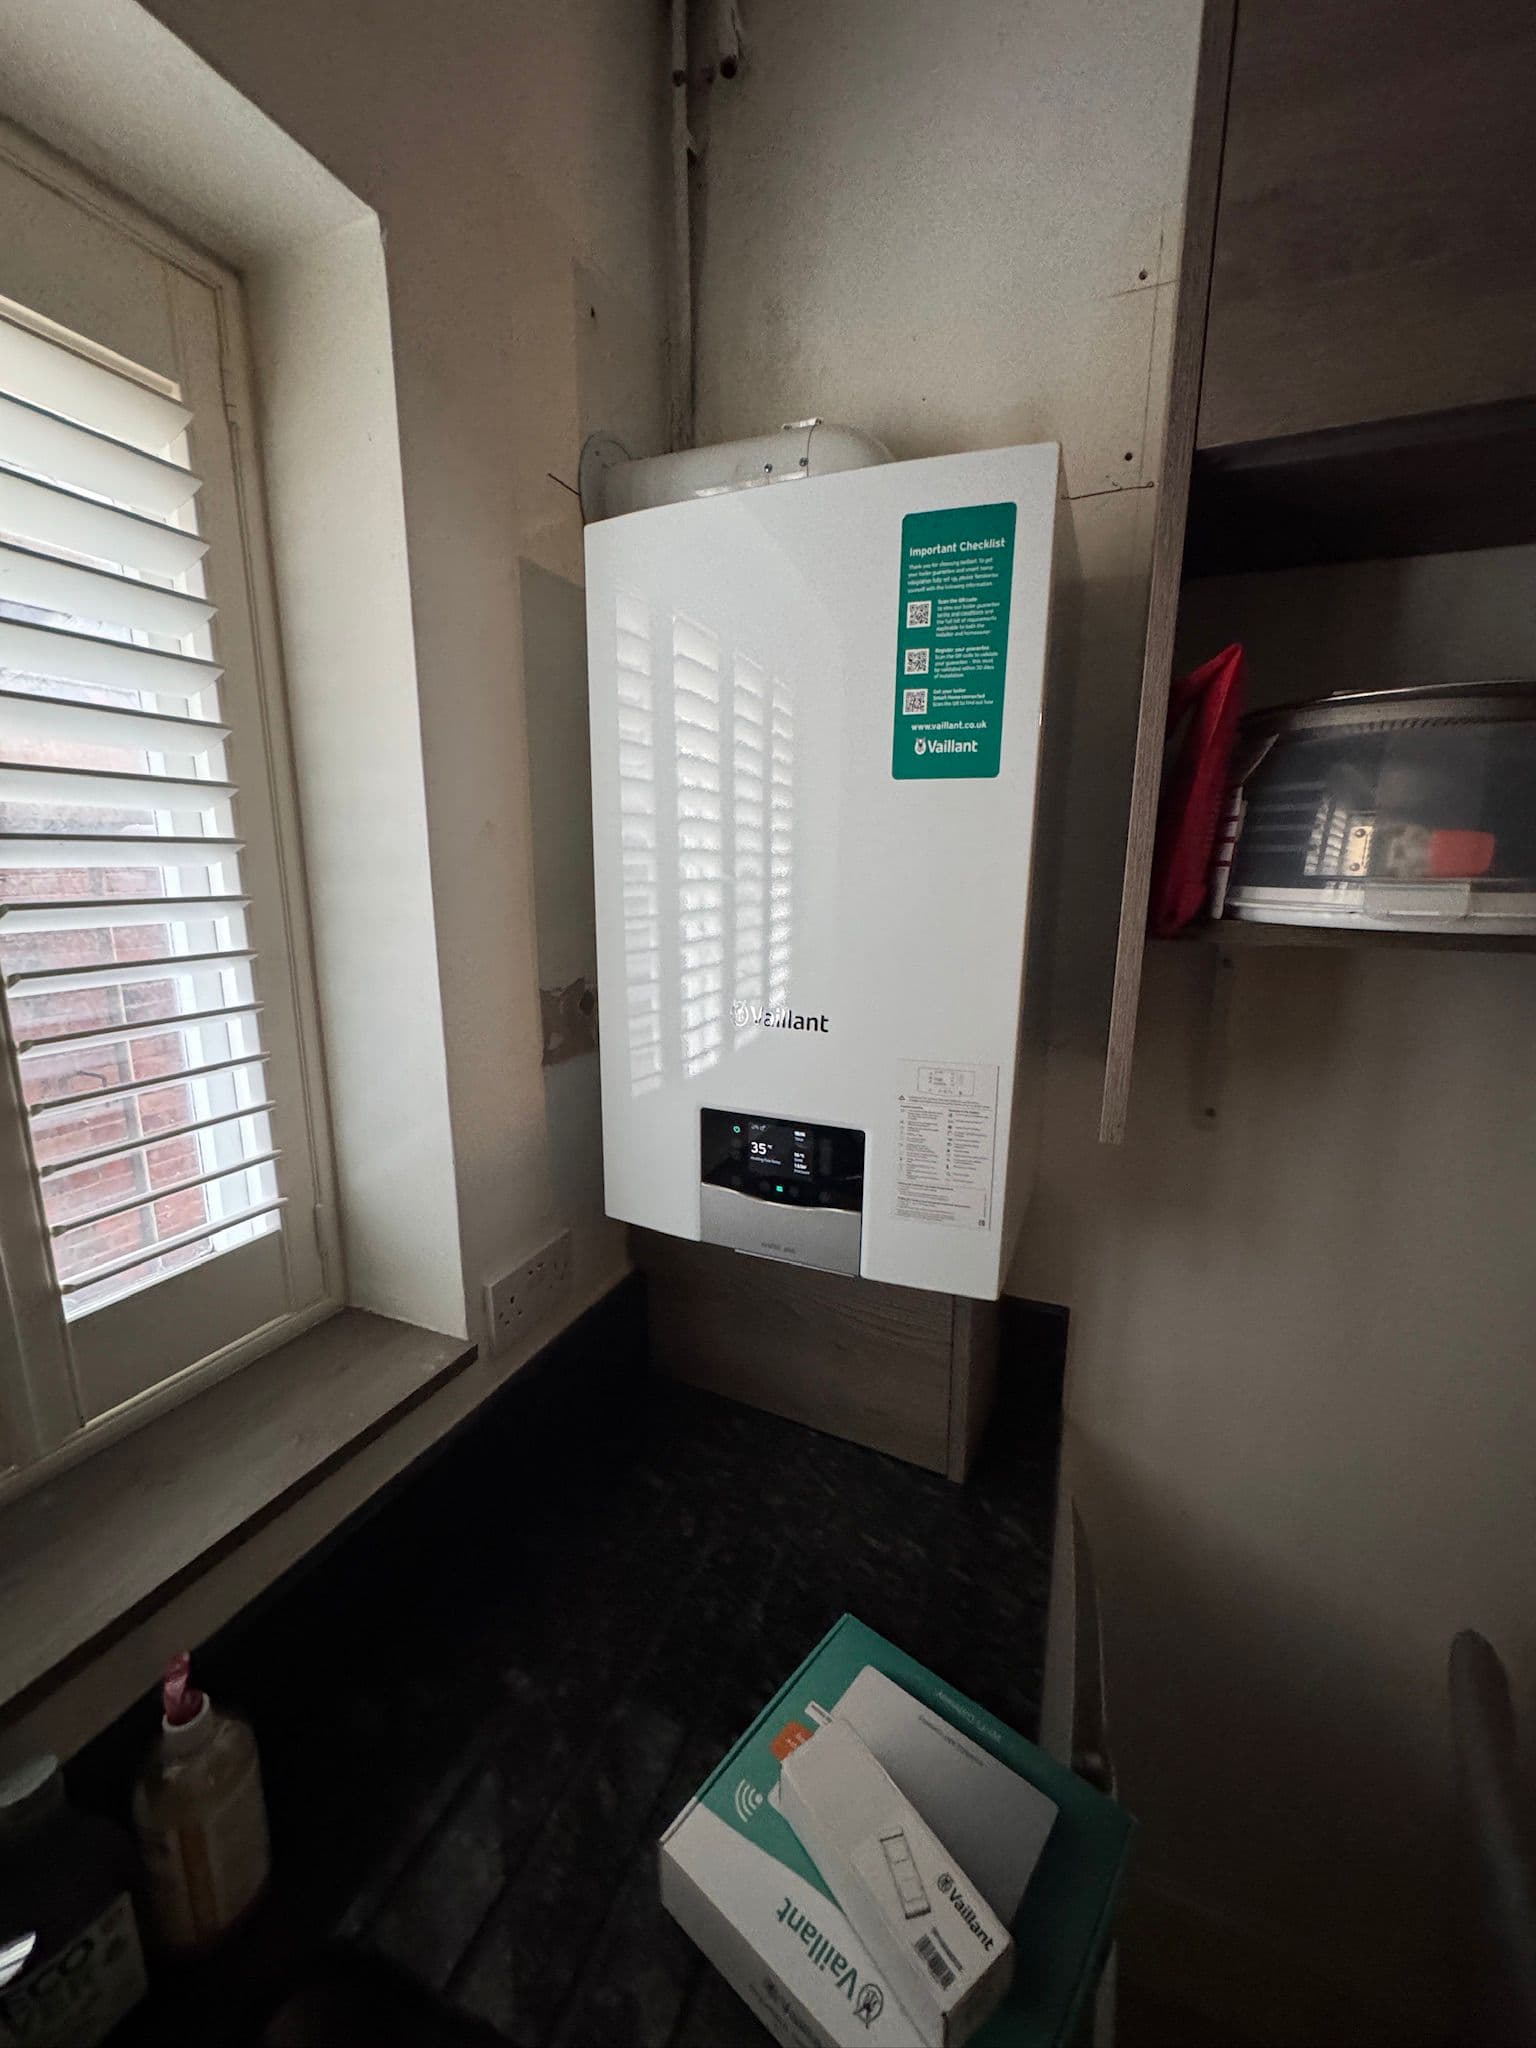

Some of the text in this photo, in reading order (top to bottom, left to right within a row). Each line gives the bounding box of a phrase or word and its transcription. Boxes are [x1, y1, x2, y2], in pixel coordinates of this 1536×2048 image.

[909, 537, 1006, 558] Important Checklist
[911, 720, 987, 731] www.vaillant.co.uk
[928, 739, 978, 753] Vaillant
[750, 1005, 829, 1033] Vaillant
[948, 1886, 996, 1952] Vaillant
[775, 1896, 860, 2001] Vaillant
